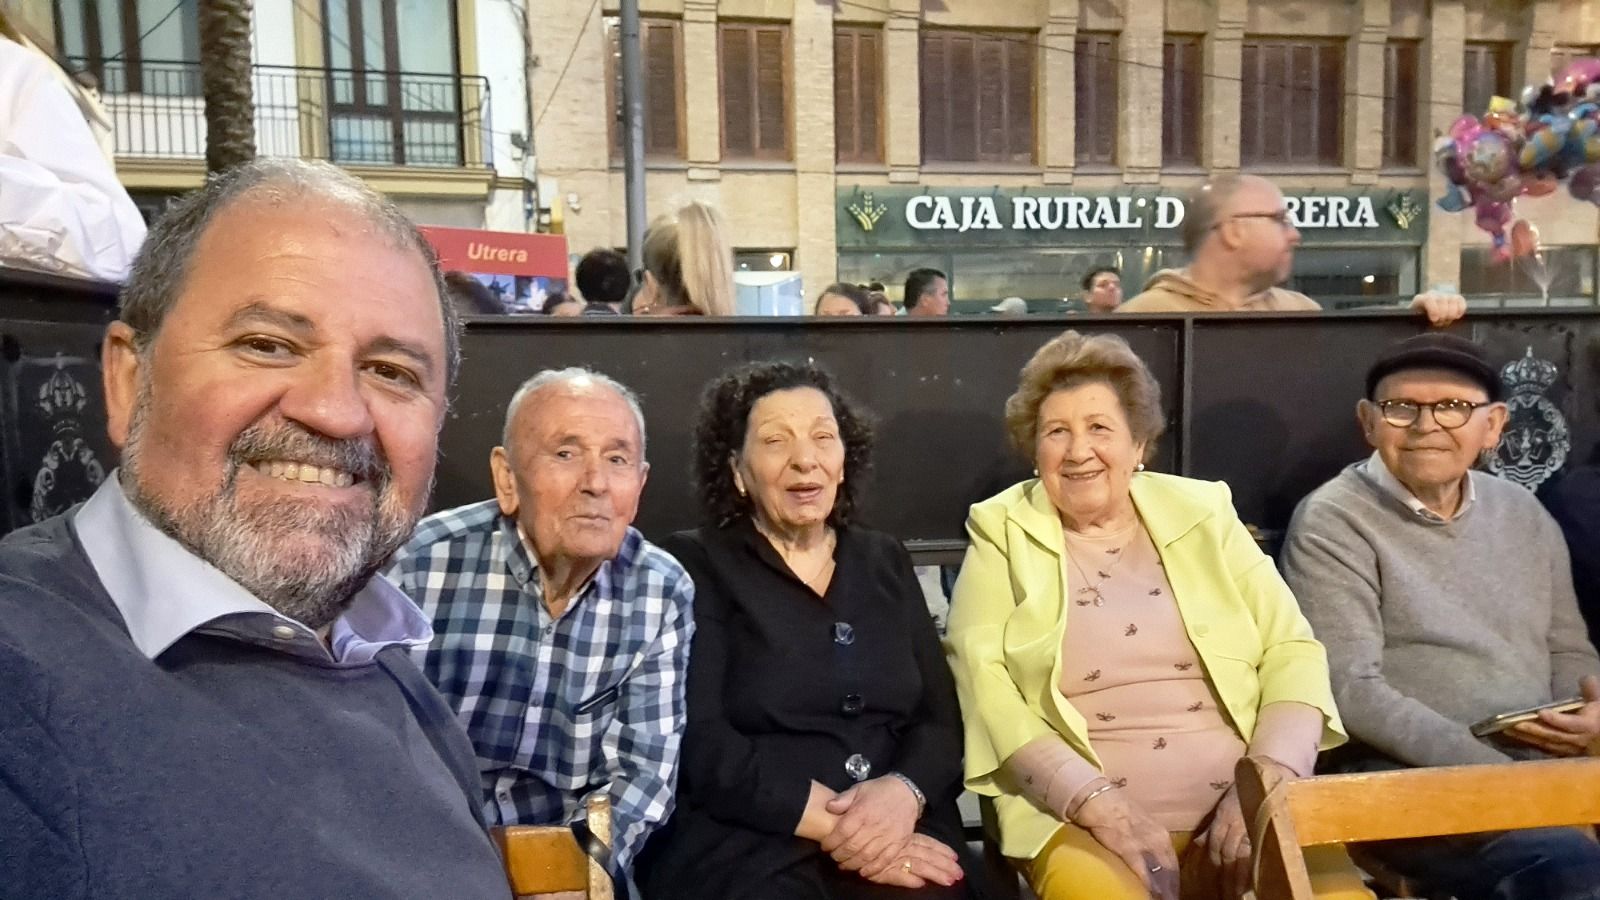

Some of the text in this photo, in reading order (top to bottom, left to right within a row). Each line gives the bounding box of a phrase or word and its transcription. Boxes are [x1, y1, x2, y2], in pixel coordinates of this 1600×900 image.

[905, 195, 1379, 232] CAJA RURAL D RERA
[467, 243, 529, 262] Utrera
